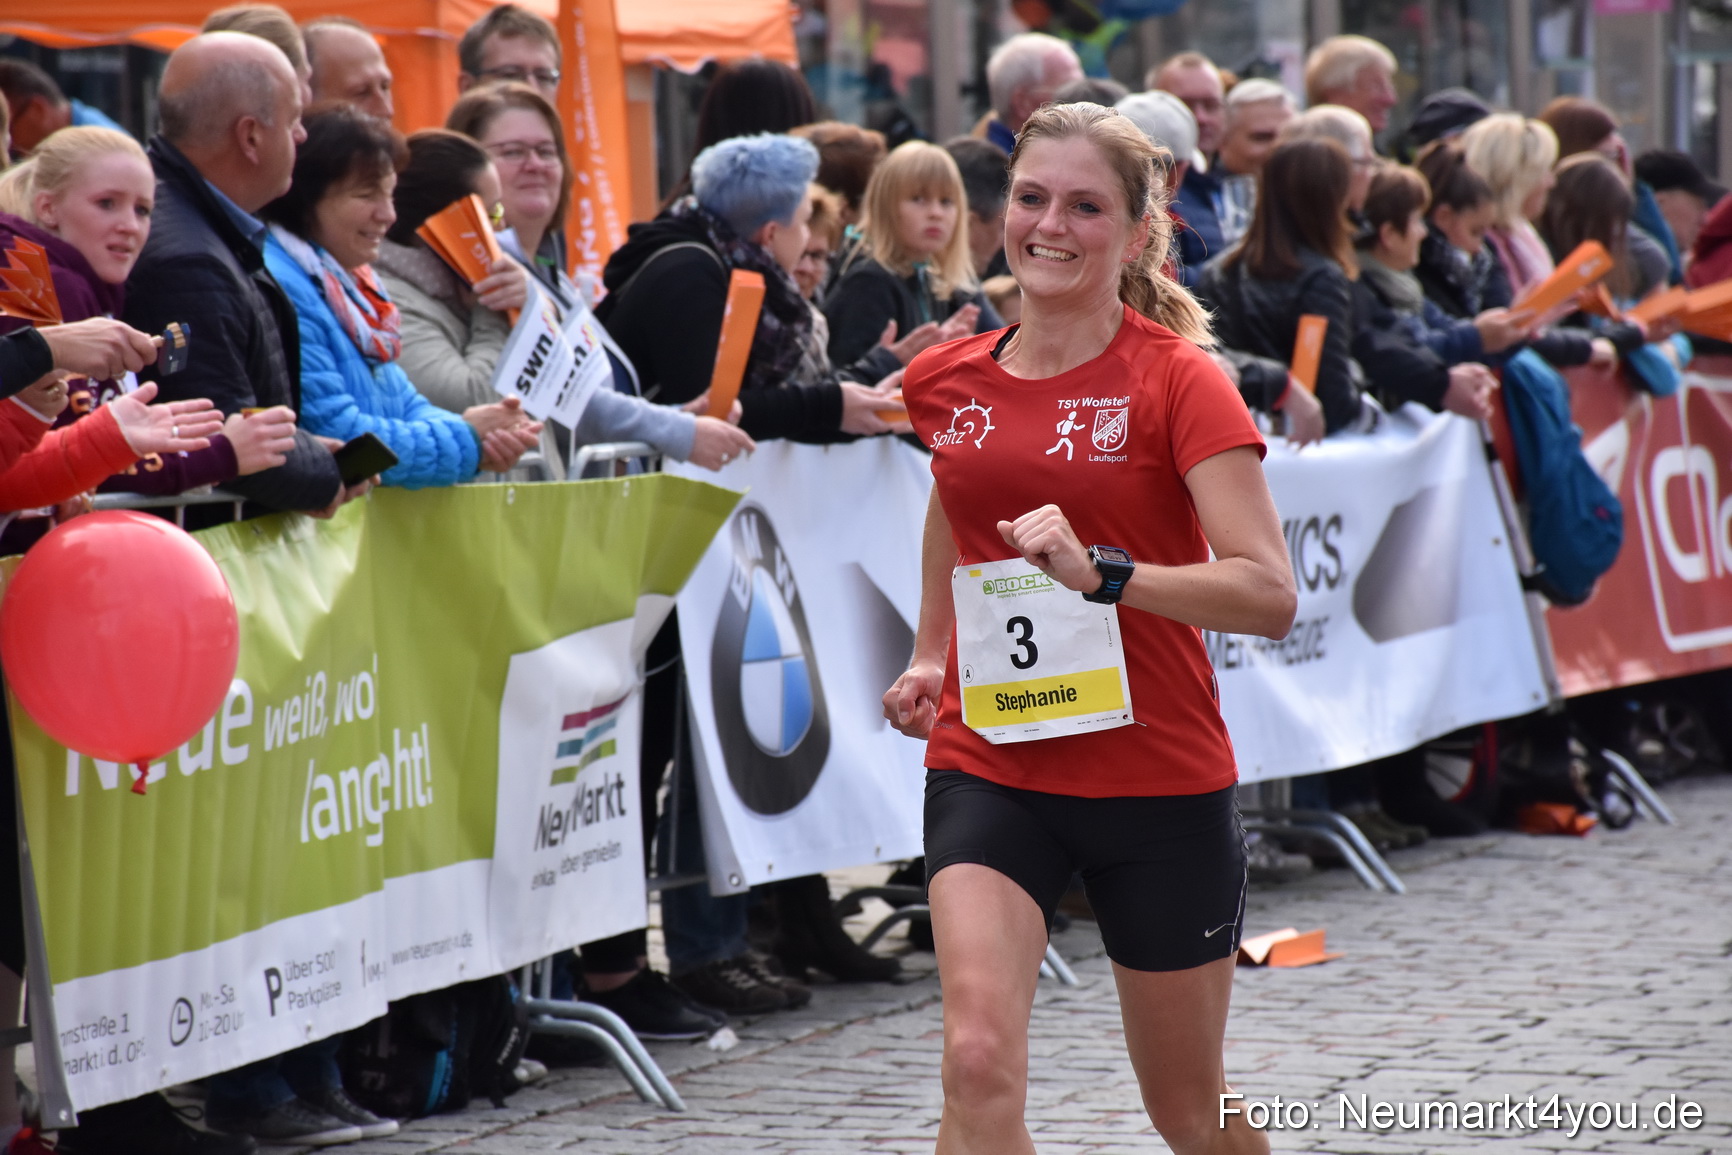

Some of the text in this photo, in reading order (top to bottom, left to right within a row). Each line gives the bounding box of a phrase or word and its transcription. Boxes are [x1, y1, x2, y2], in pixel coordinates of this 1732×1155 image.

[515, 333, 554, 397] swn
[1057, 394, 1130, 410] TSV Wolfstein
[930, 430, 967, 449] Spitz
[1088, 453, 1128, 463] Laufsport
[1006, 615, 1039, 670] 3
[264, 670, 329, 752] weiß,
[995, 685, 1078, 713] Stephanie
[284, 959, 315, 983] über
[316, 950, 336, 975] 500
[121, 1012, 129, 1034] 1
[108, 1043, 123, 1067] d.
